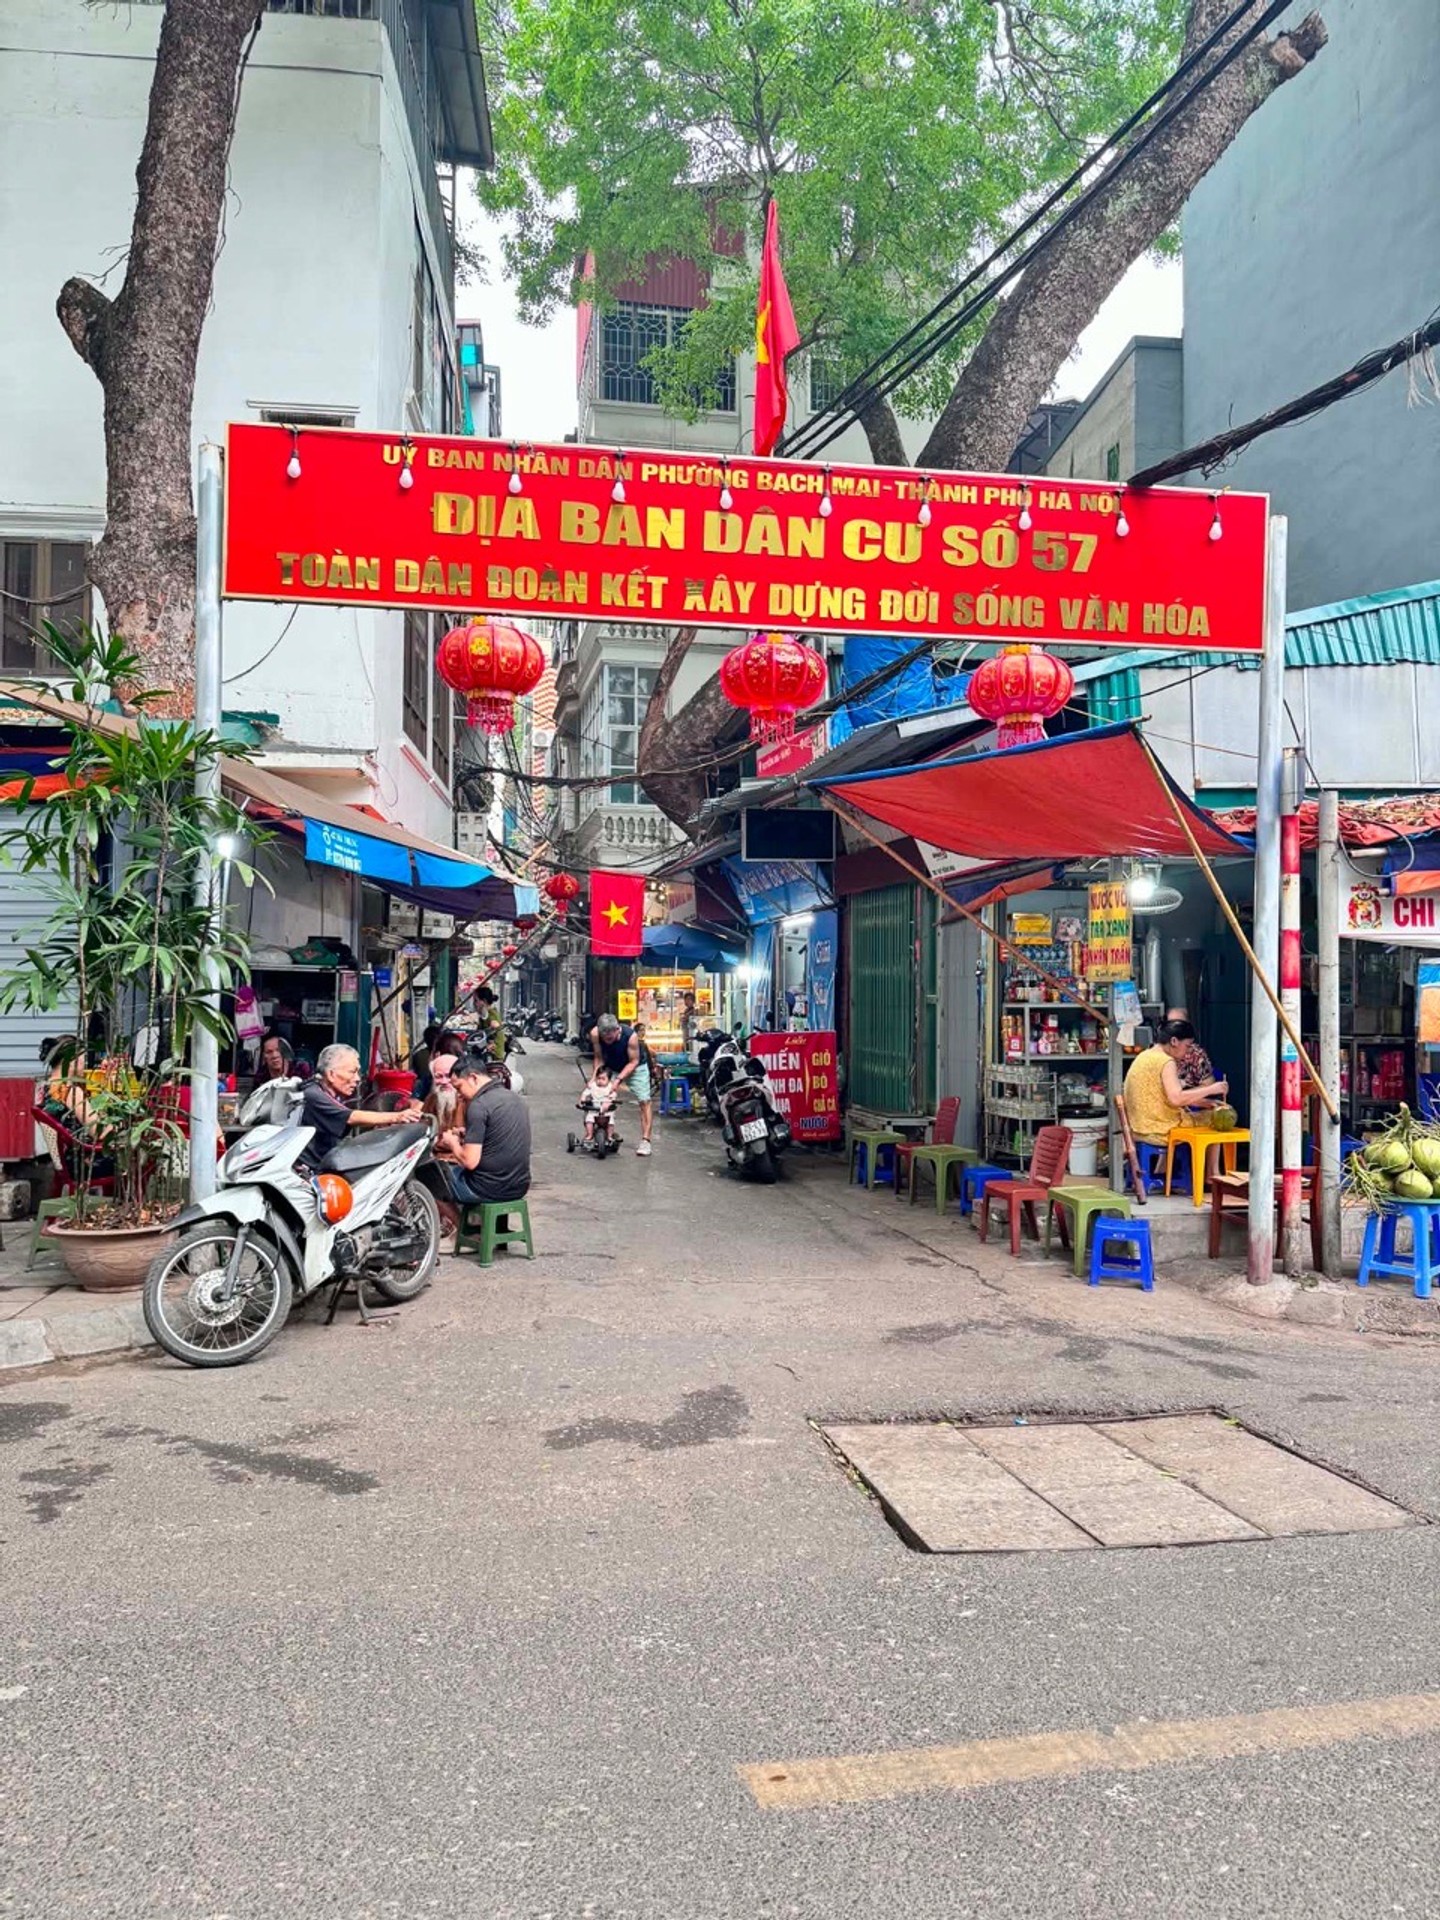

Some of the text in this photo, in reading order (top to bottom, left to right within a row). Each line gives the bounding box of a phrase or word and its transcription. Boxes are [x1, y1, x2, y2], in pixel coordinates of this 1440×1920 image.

[427, 448, 485, 470] BAN
[493, 451, 570, 476] NHÂN
[578, 456, 633, 481] DÂN
[641, 462, 749, 489] PHƯỜNG
[757, 471, 824, 495] BẠCH
[1039, 490, 1072, 510] HÀ
[430, 491, 541, 546] ĐỊA
[703, 505, 825, 559] DÂN
[942, 514, 1020, 568] SỐ
[1031, 530, 1098, 573] 57
[276, 548, 1211, 637] TOÀN DÂN ĐOÀN KẾT XÂY DỰNG ĐỜI SỐNG VĂN HÓA
[1393, 896, 1435, 927] CHI
